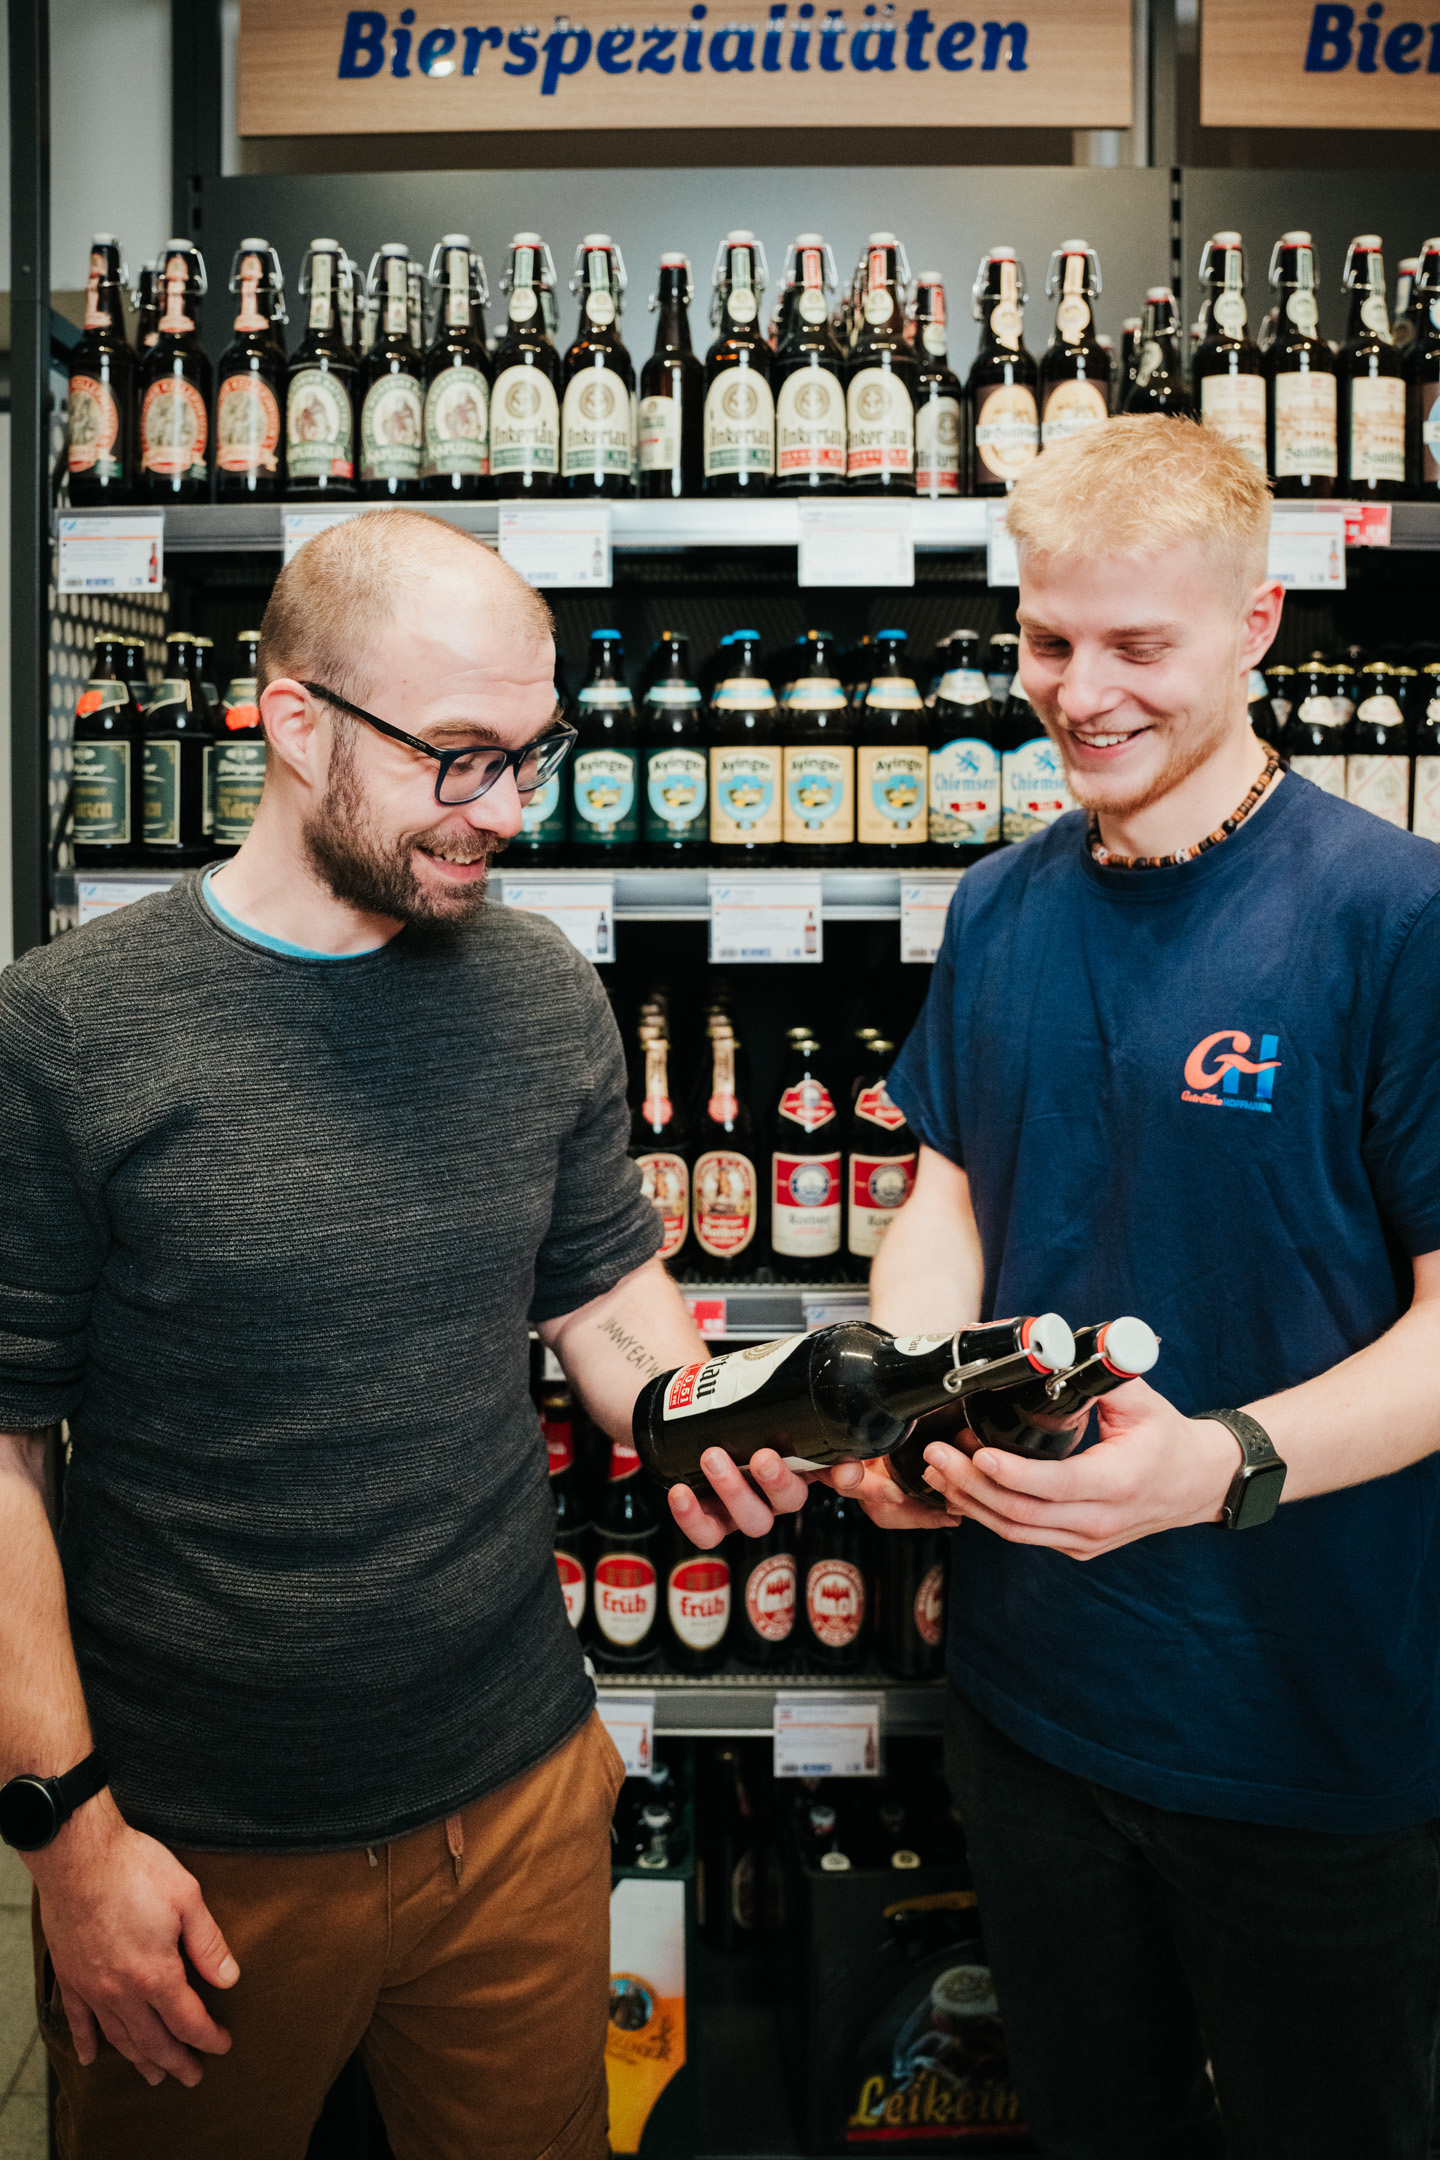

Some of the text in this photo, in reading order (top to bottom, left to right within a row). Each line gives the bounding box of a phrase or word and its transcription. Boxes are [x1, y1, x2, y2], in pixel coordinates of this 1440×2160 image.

[338, 4, 1028, 95] Bierspezialitäten
[597, 1316, 637, 1351] JIMMY
[628, 1344, 653, 1369] EAT
